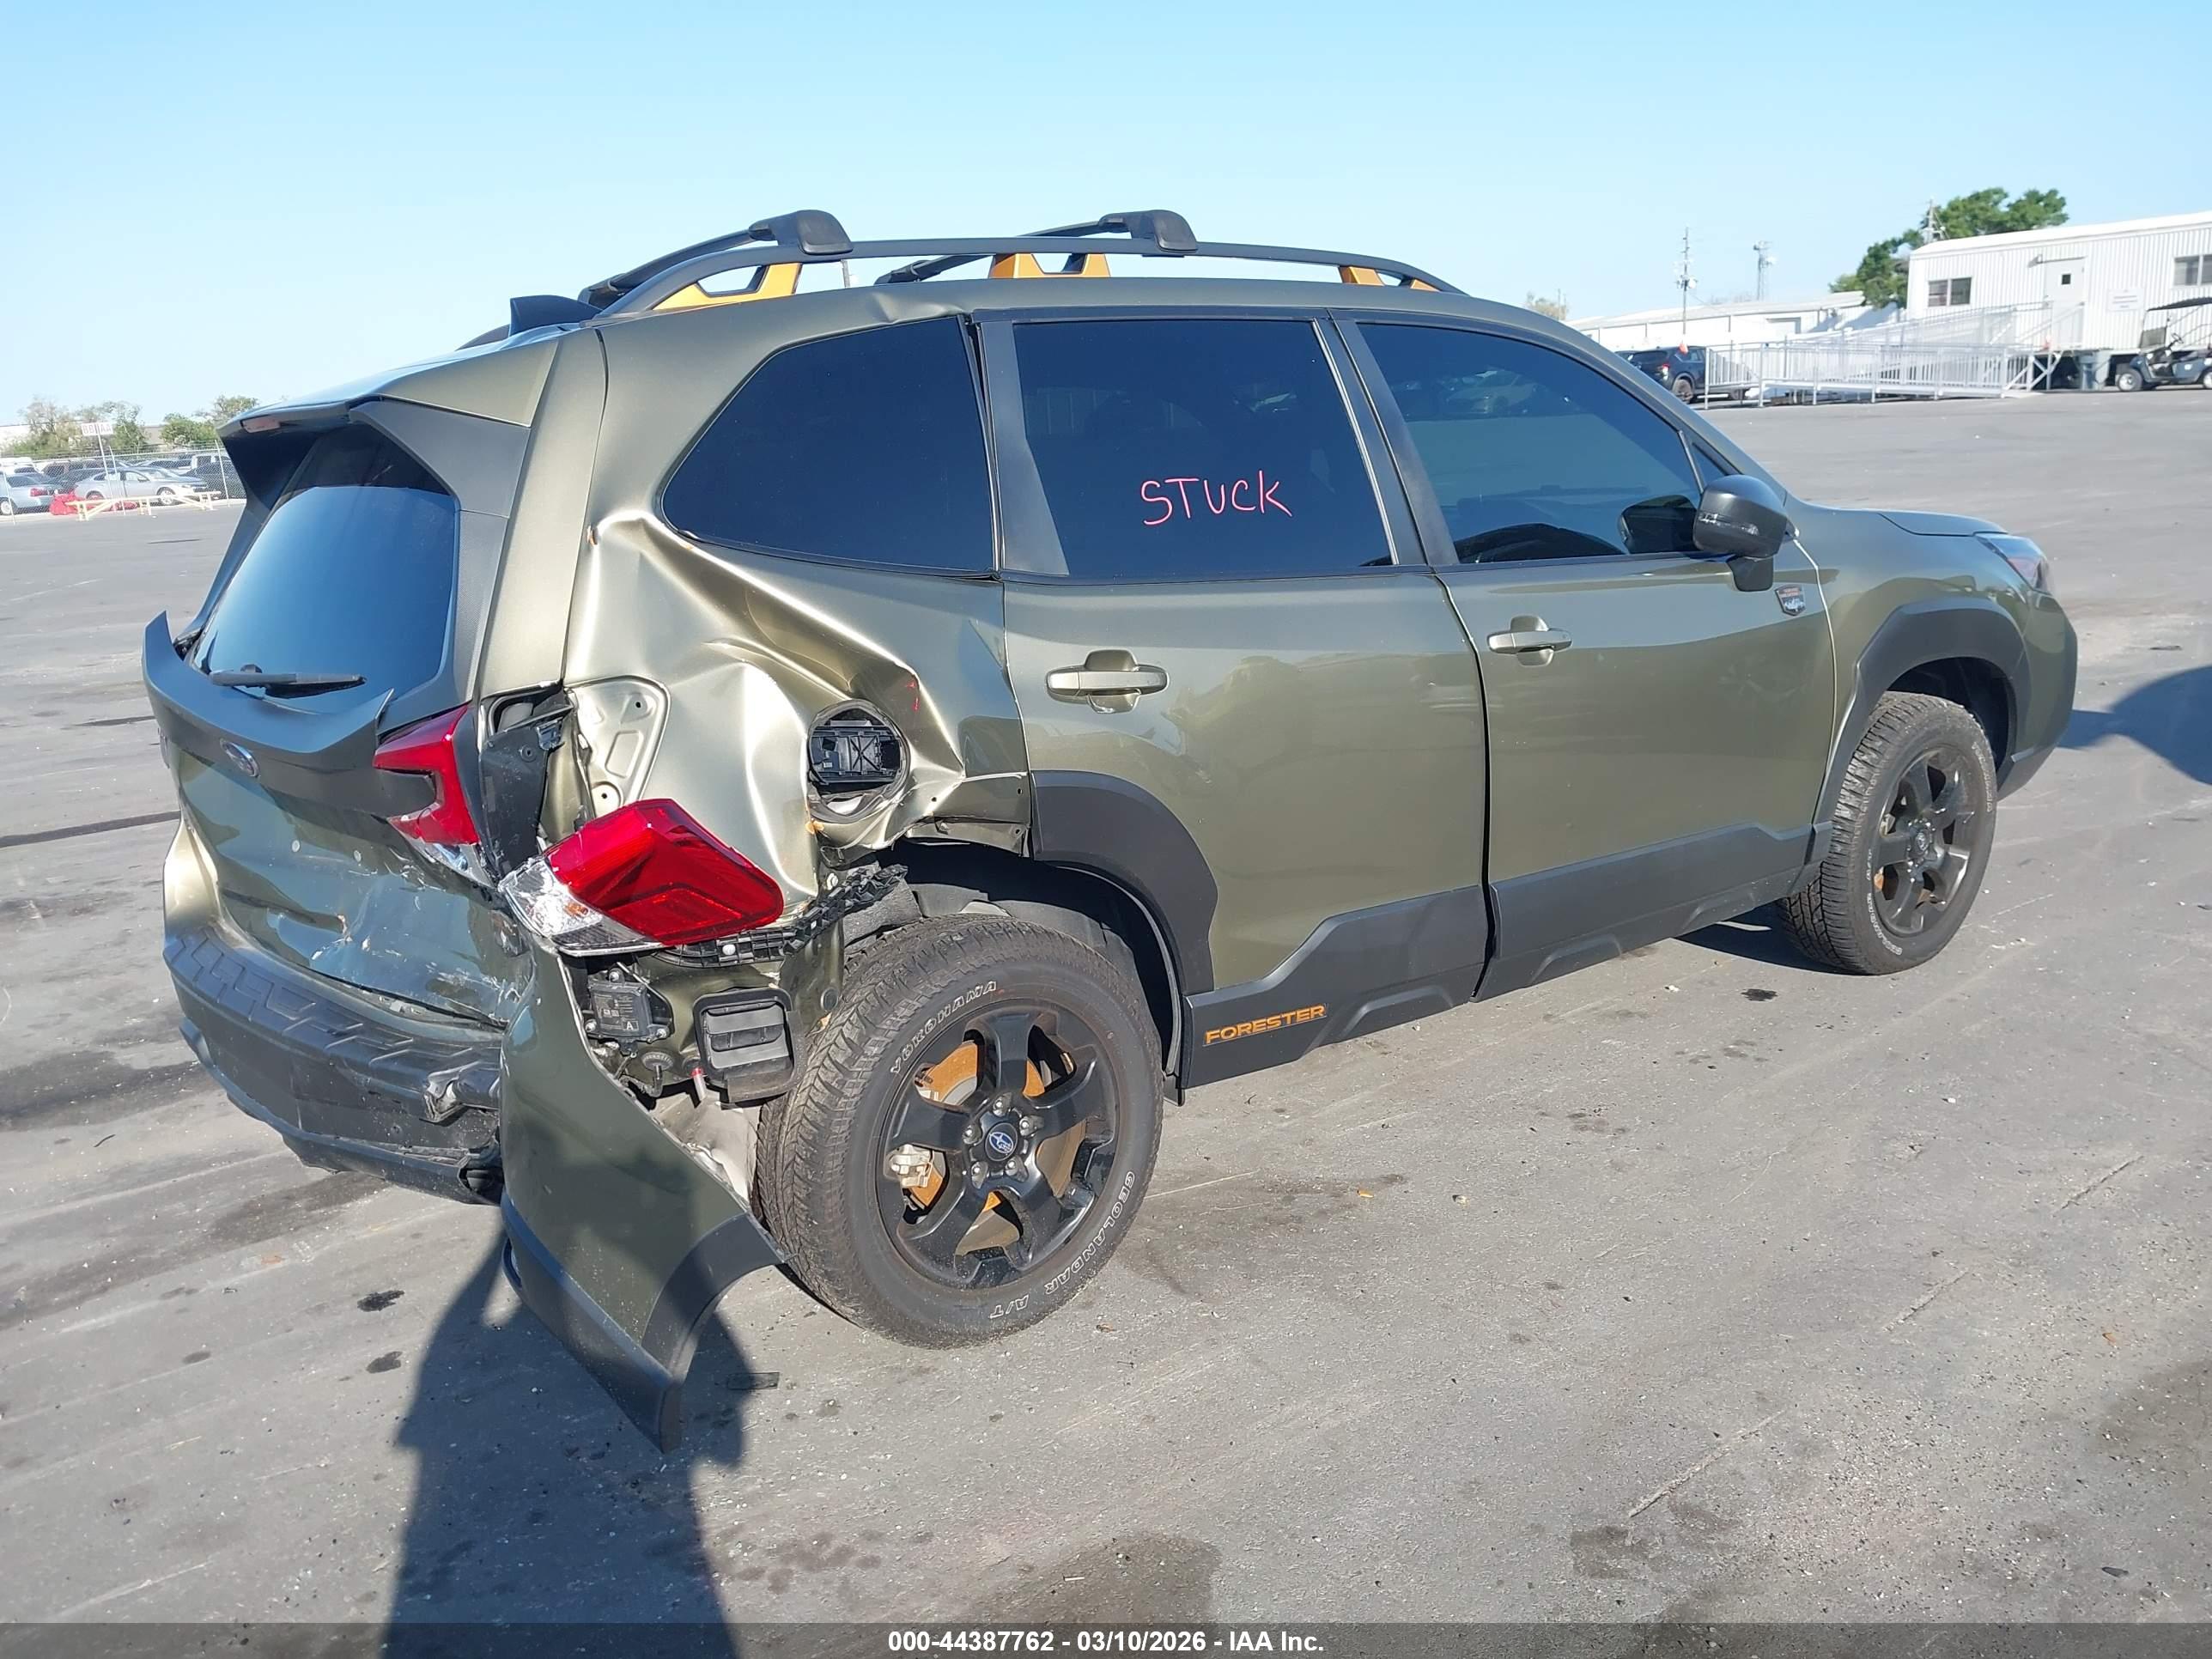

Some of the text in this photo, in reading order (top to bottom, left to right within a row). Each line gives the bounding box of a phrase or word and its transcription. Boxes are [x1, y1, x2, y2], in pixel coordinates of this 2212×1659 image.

[1140, 469, 1292, 526] STUCK
[626, 1020, 635, 1031] A
[890, 980, 997, 1074] YOKOHAMA
[1205, 1004, 1327, 1045] FORESTER
[988, 1170, 1136, 1320] GEOLANDAR A/T
